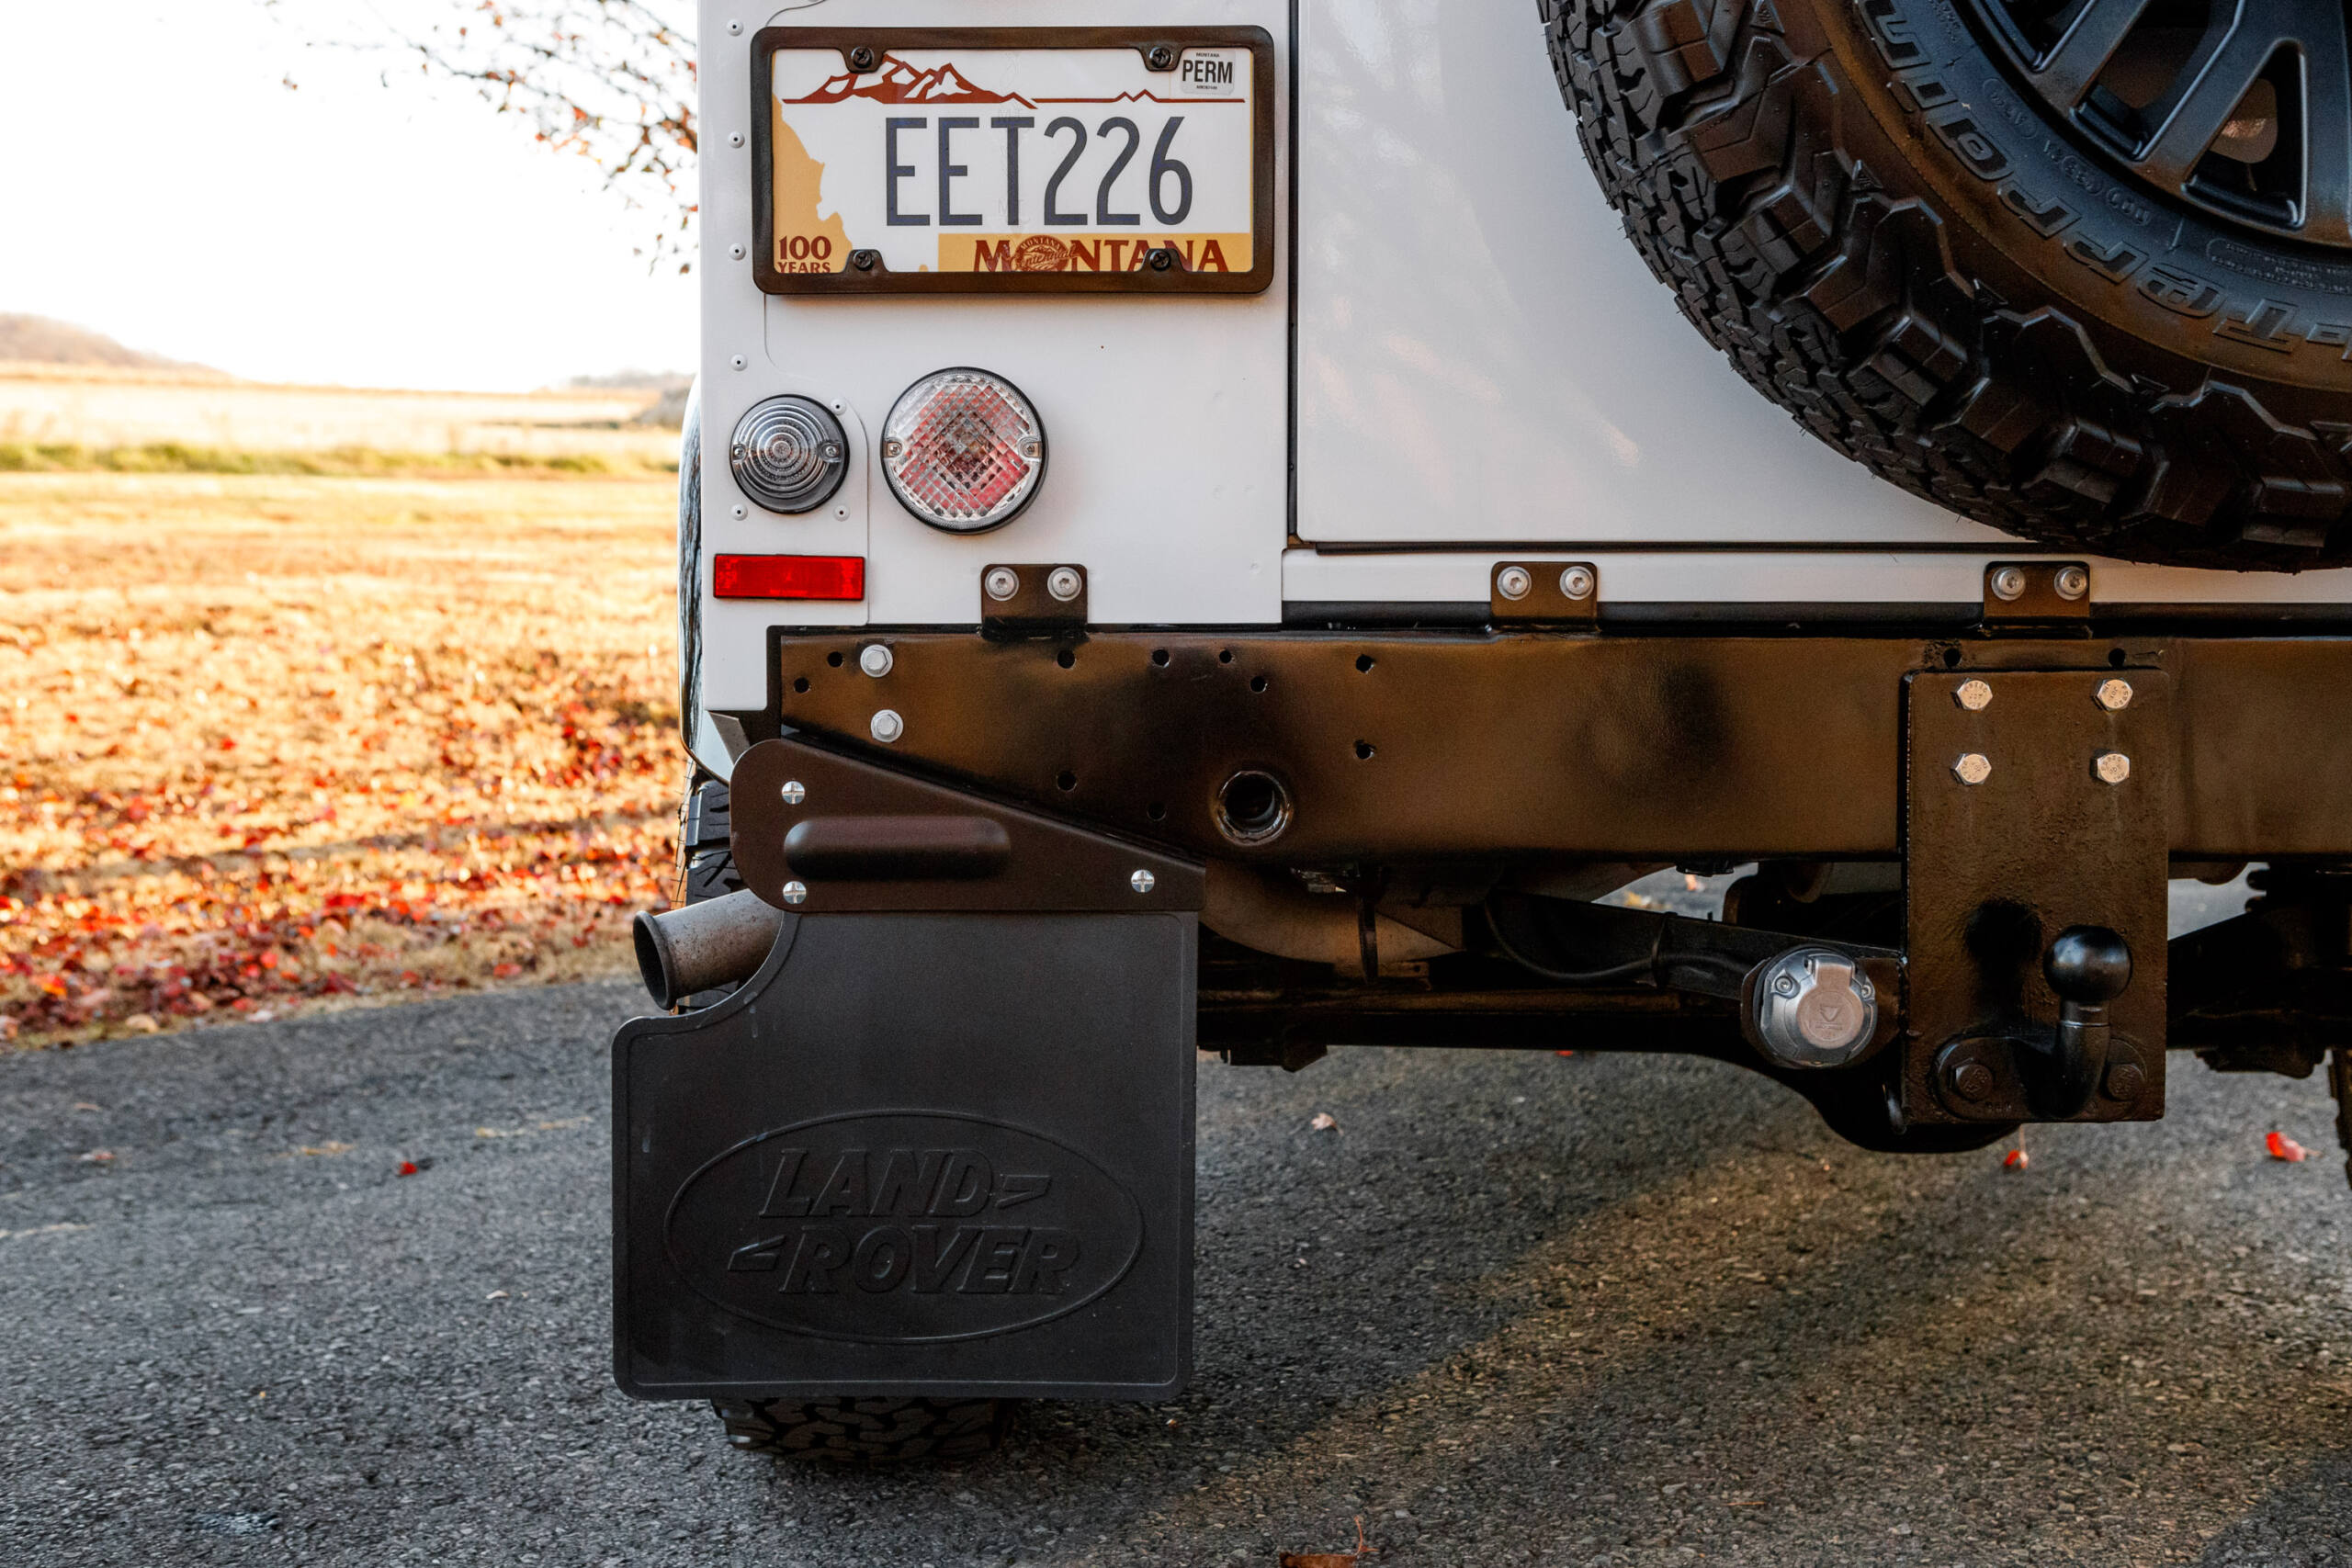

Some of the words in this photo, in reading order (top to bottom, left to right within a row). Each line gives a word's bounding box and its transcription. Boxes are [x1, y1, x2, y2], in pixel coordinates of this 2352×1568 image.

[1182, 60, 1233, 84] PERM
[886, 117, 1193, 226] EET226
[777, 262, 831, 274] YEARS
[779, 235, 831, 260] 100
[759, 1148, 995, 1219] LAND
[778, 1224, 1080, 1295] ROVER
